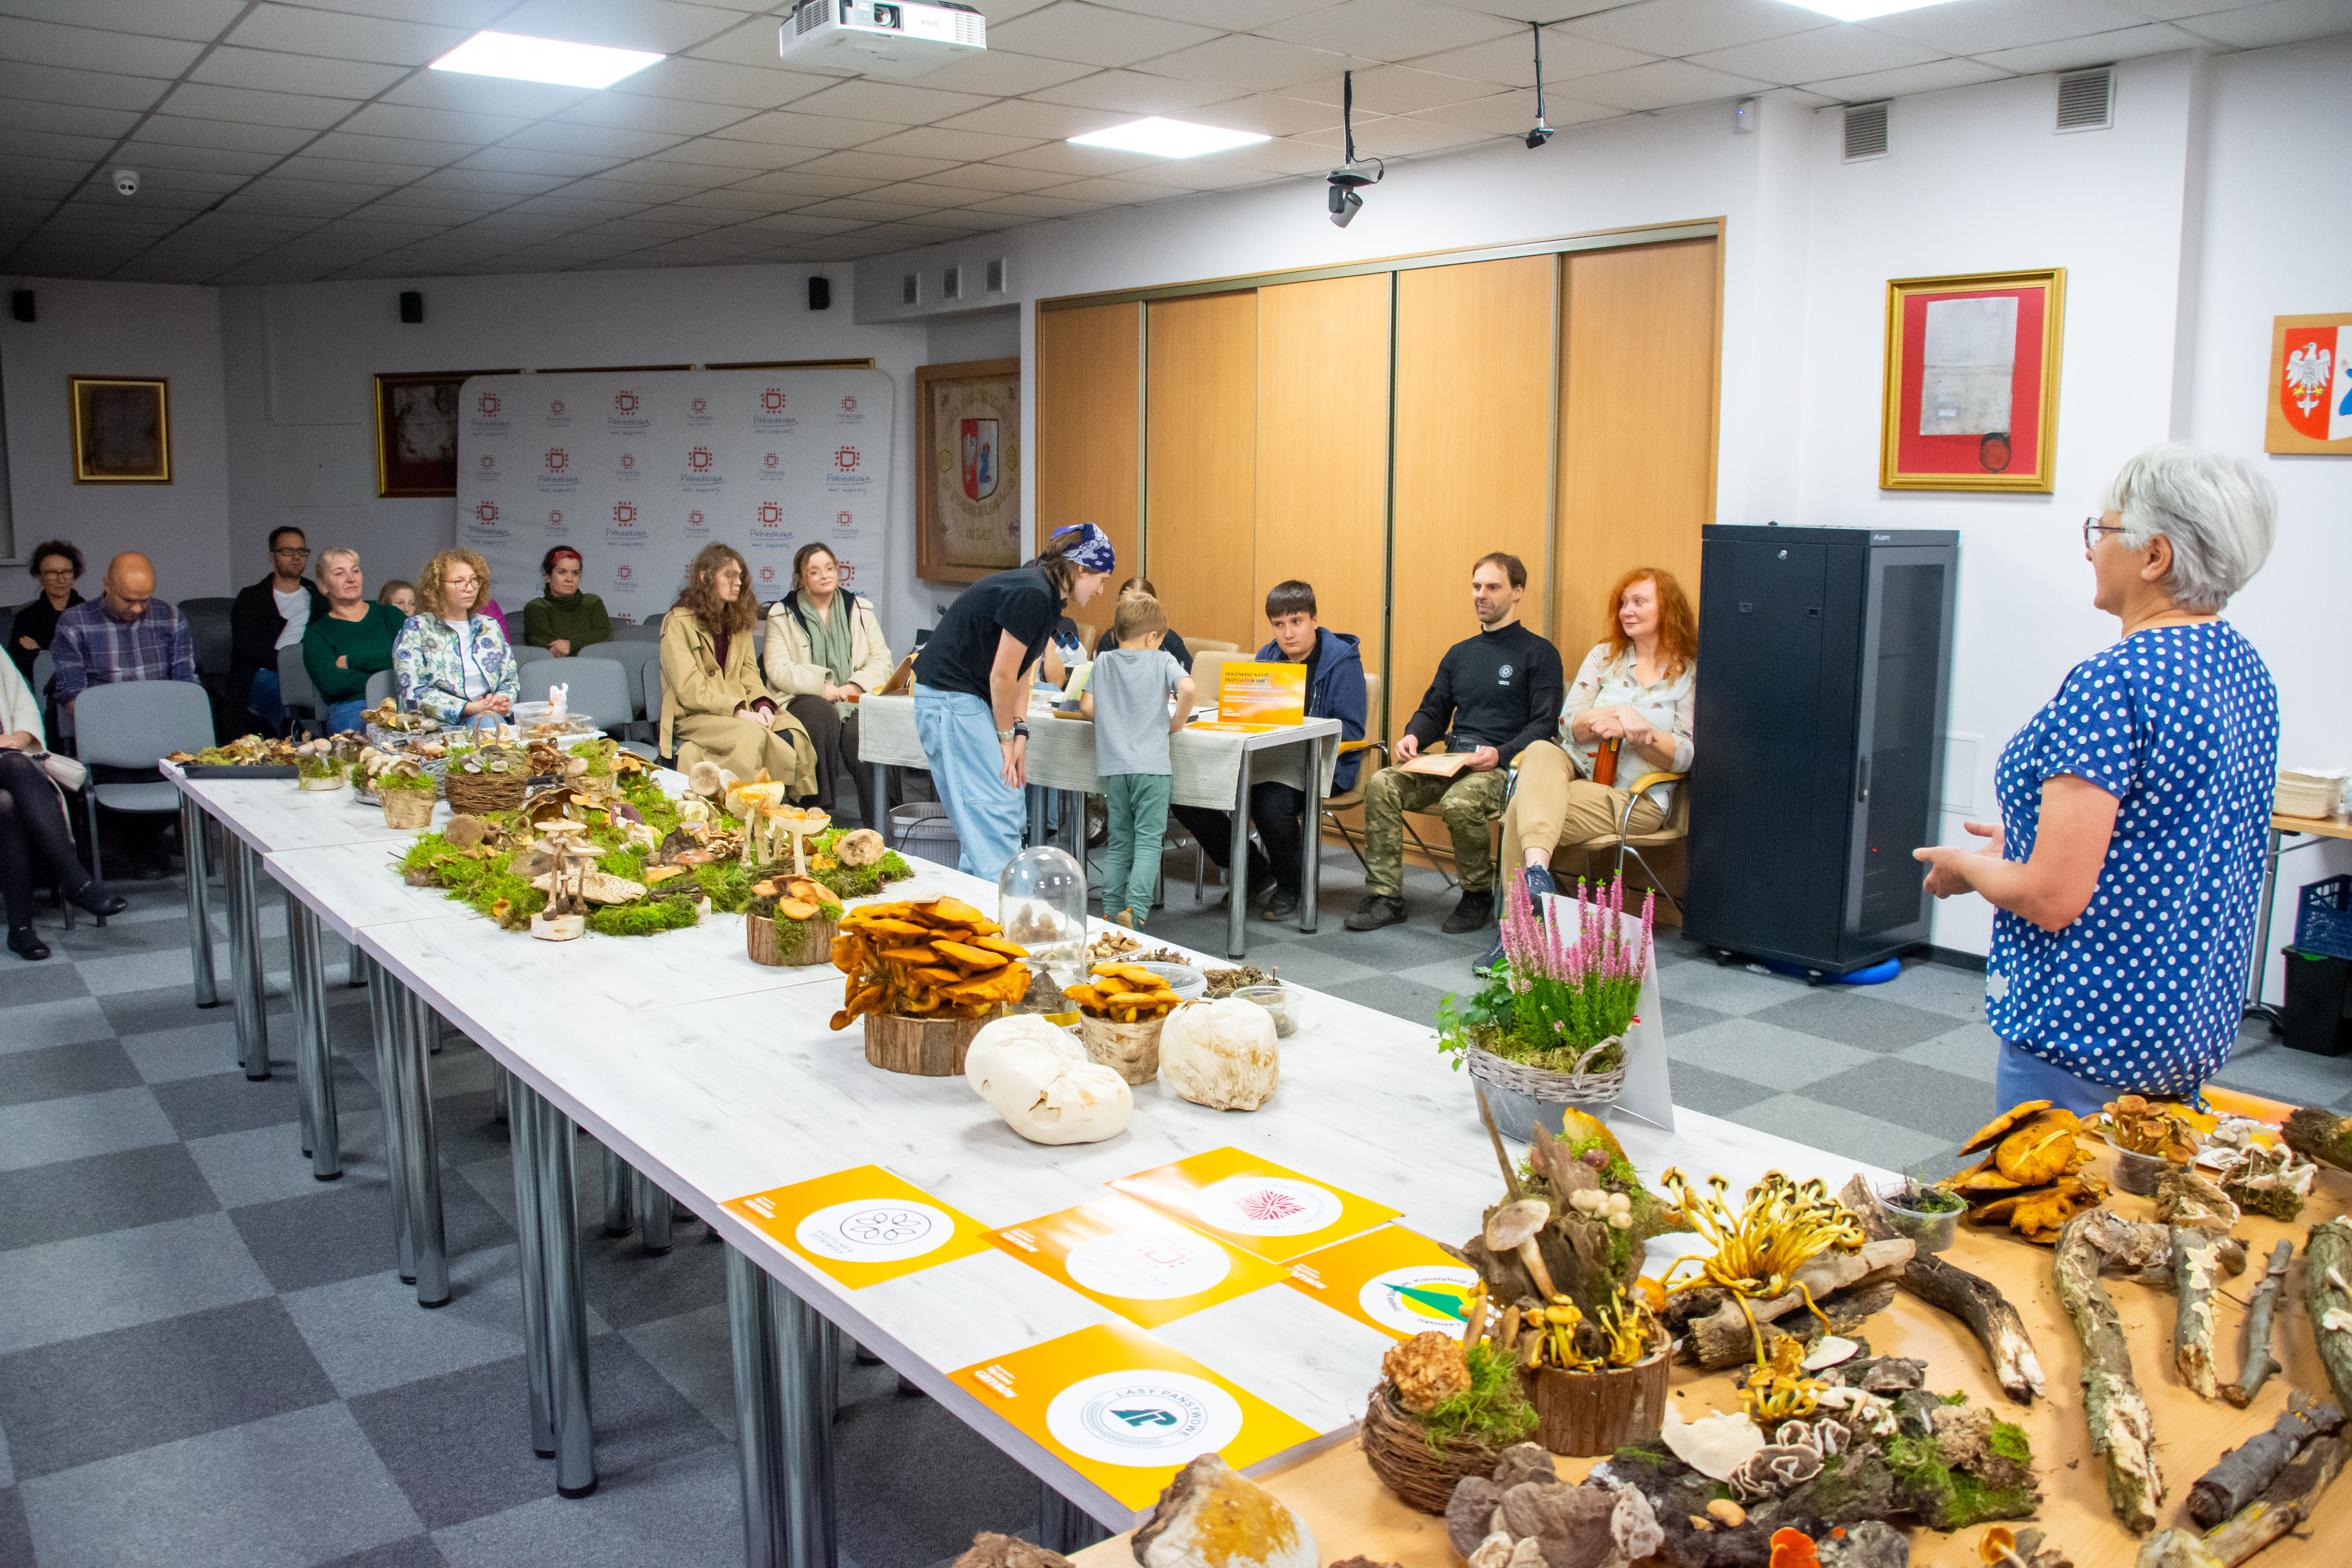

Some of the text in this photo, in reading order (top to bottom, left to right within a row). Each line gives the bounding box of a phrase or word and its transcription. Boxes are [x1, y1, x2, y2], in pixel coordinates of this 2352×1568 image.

[608, 416, 648, 425] Pobiedziska
[754, 416, 796, 424] Pobiedziska
[681, 474, 722, 482] Pobiedziska
[827, 474, 870, 482] Pobiedziska
[809, 1233, 844, 1254] OSTROWSKA
[817, 1230, 854, 1252] KASZTELANIA
[1417, 1318, 1461, 1327] Letnisku
[1116, 1388, 1156, 1397] LASY
